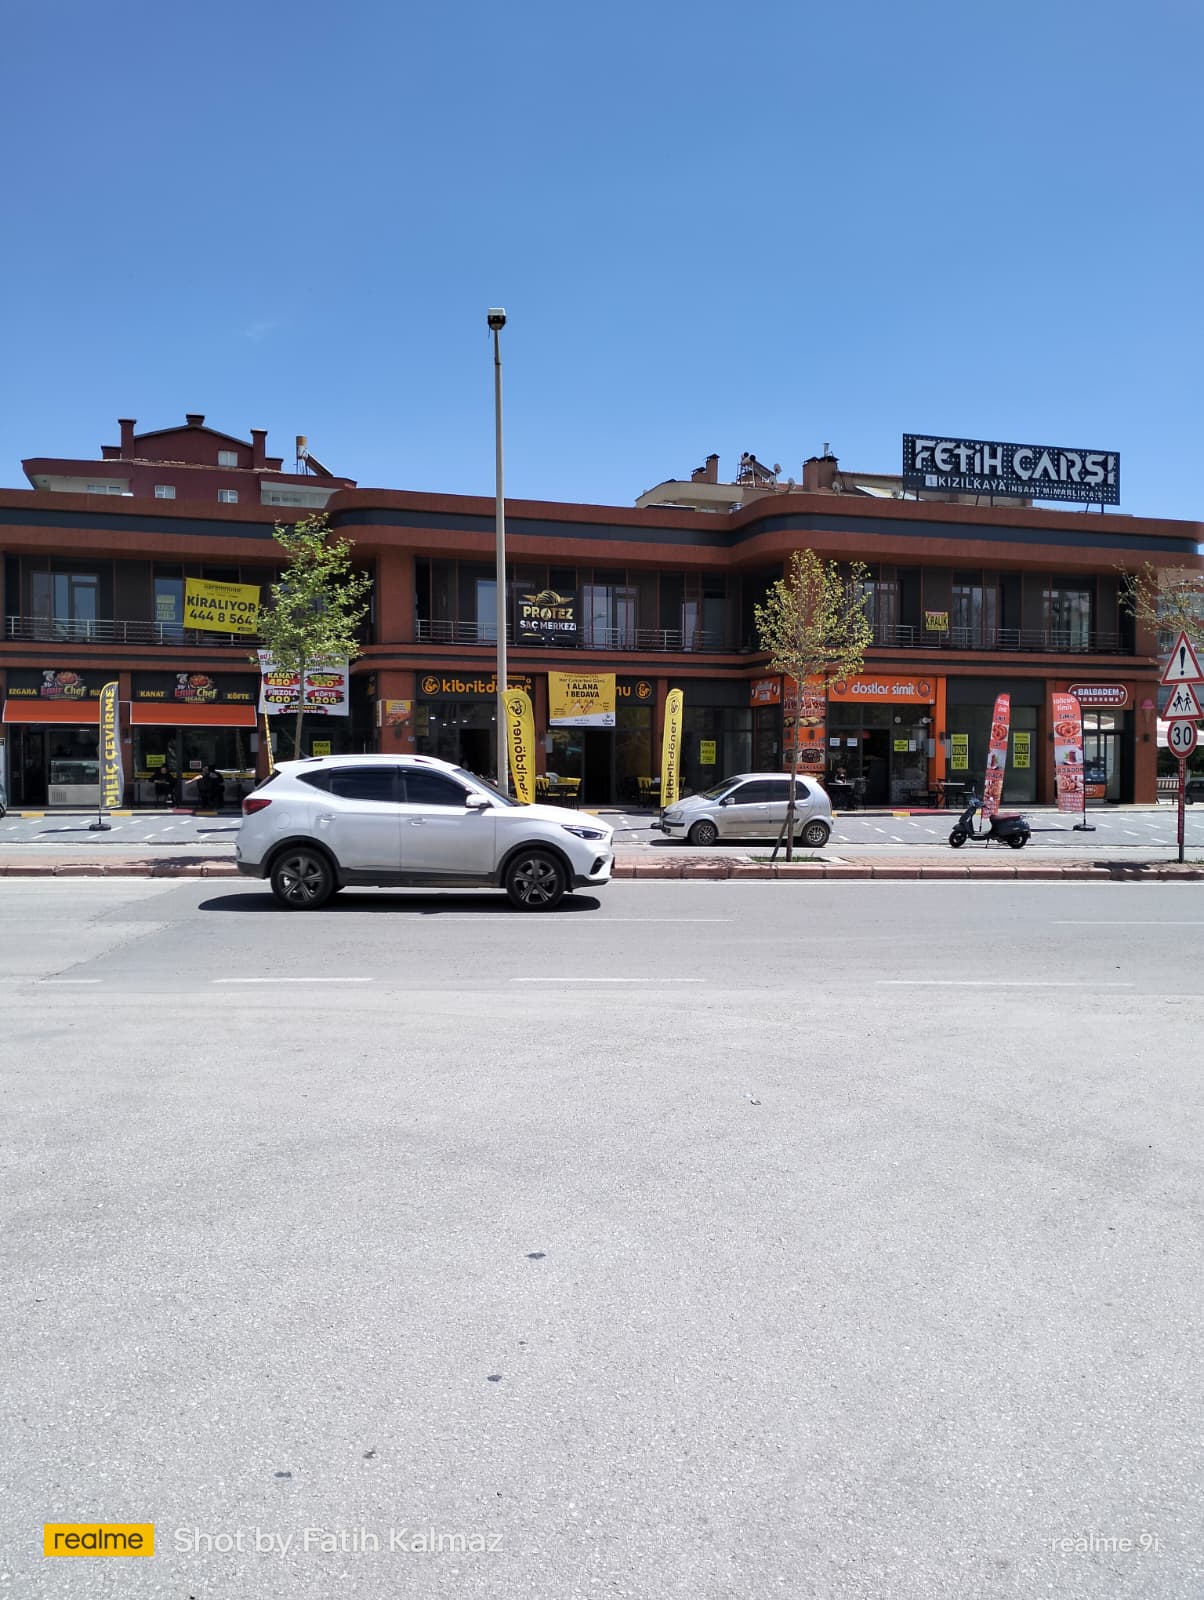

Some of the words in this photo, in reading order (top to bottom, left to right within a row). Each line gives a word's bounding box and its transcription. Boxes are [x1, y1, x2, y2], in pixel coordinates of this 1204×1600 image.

[938, 476, 1006, 491] KIZILKAYA
[187, 594, 256, 612] KİRALIYOR
[190, 609, 214, 621] 444
[218, 612, 225, 622] 8
[229, 613, 253, 625] 564
[523, 606, 573, 620] PROTEZ
[520, 620, 539, 631] SAÇ
[64, 685, 87, 697] Chef
[196, 688, 218, 699] Chef
[851, 681, 889, 695] dostlar
[892, 682, 915, 695] simit
[227, 692, 249, 700] KÖFTE
[268, 695, 291, 703] 400
[103, 687, 118, 761] ÇEVİRME
[1173, 726, 1192, 746] 30
[103, 763, 120, 807] PİLİÇ
